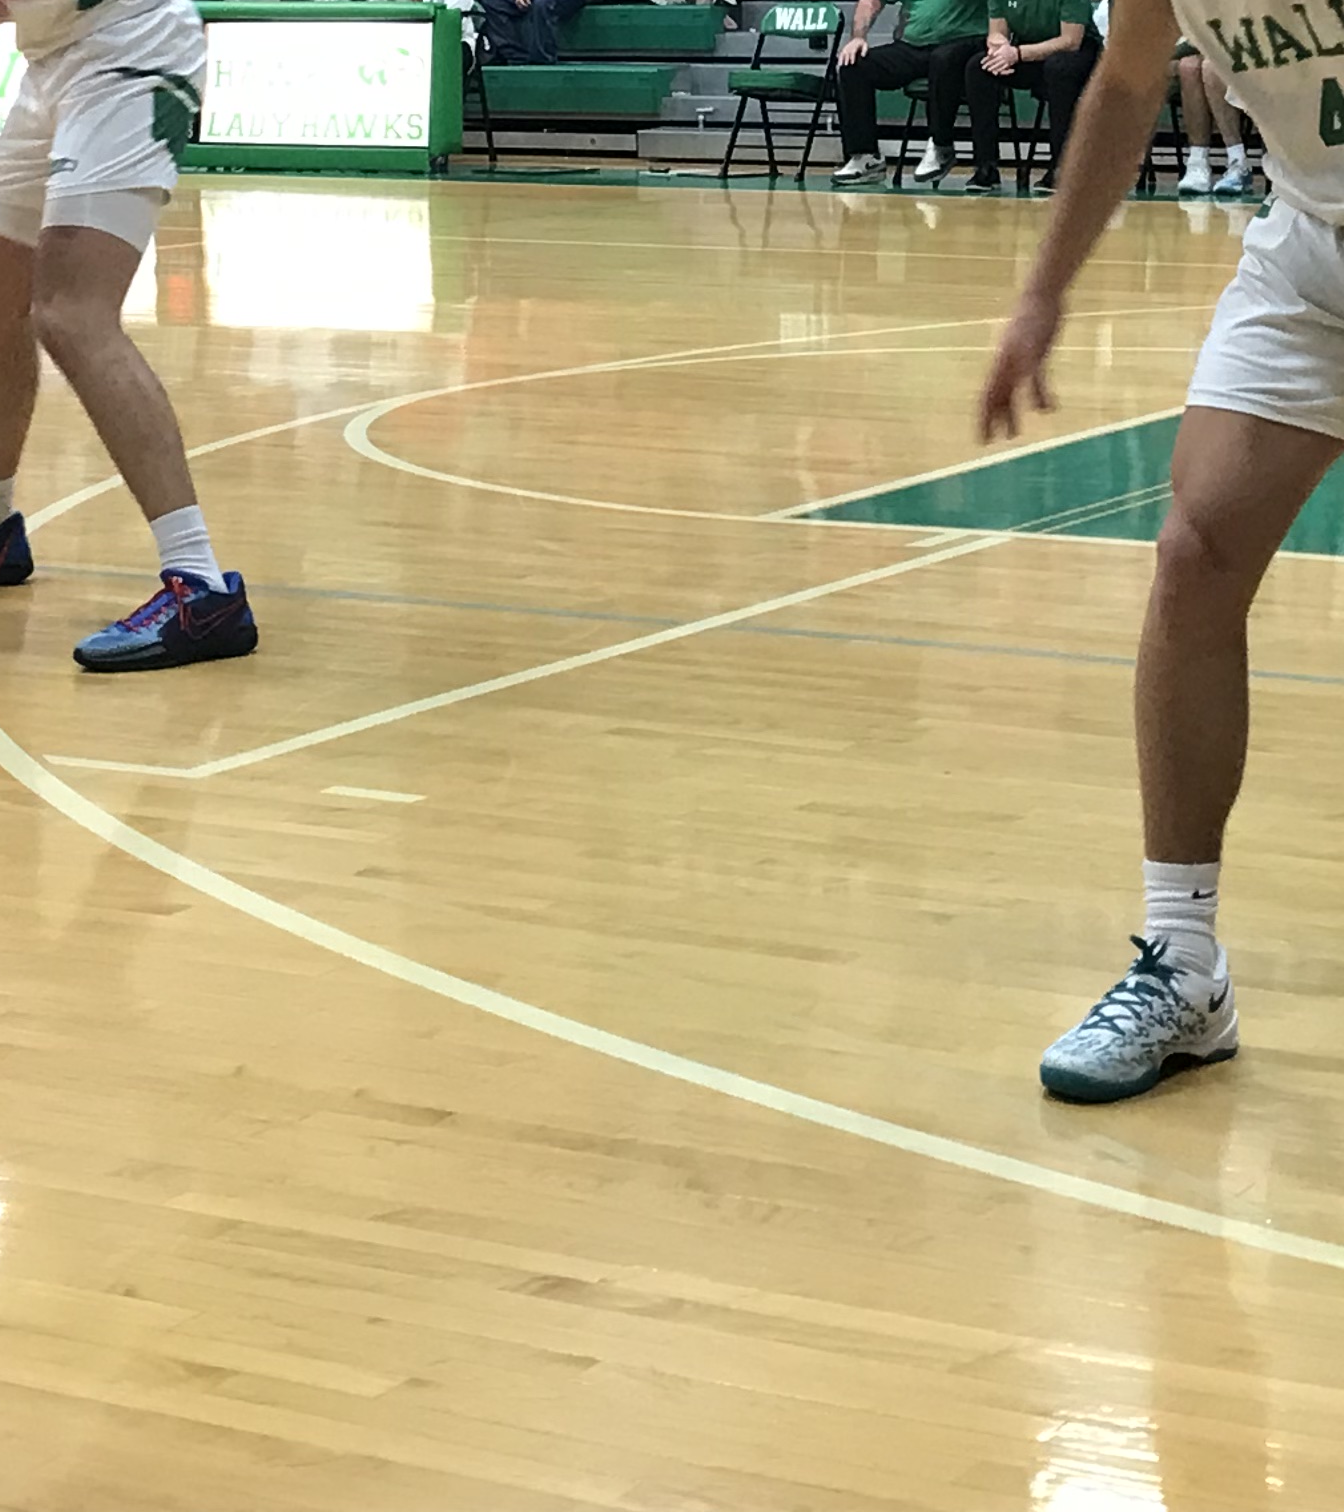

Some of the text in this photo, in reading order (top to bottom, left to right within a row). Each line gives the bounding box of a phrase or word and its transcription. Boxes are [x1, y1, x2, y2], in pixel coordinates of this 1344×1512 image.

[775, 7, 828, 30] WALL
[207, 112, 291, 138] LADY
[300, 113, 424, 139] HAWKS
